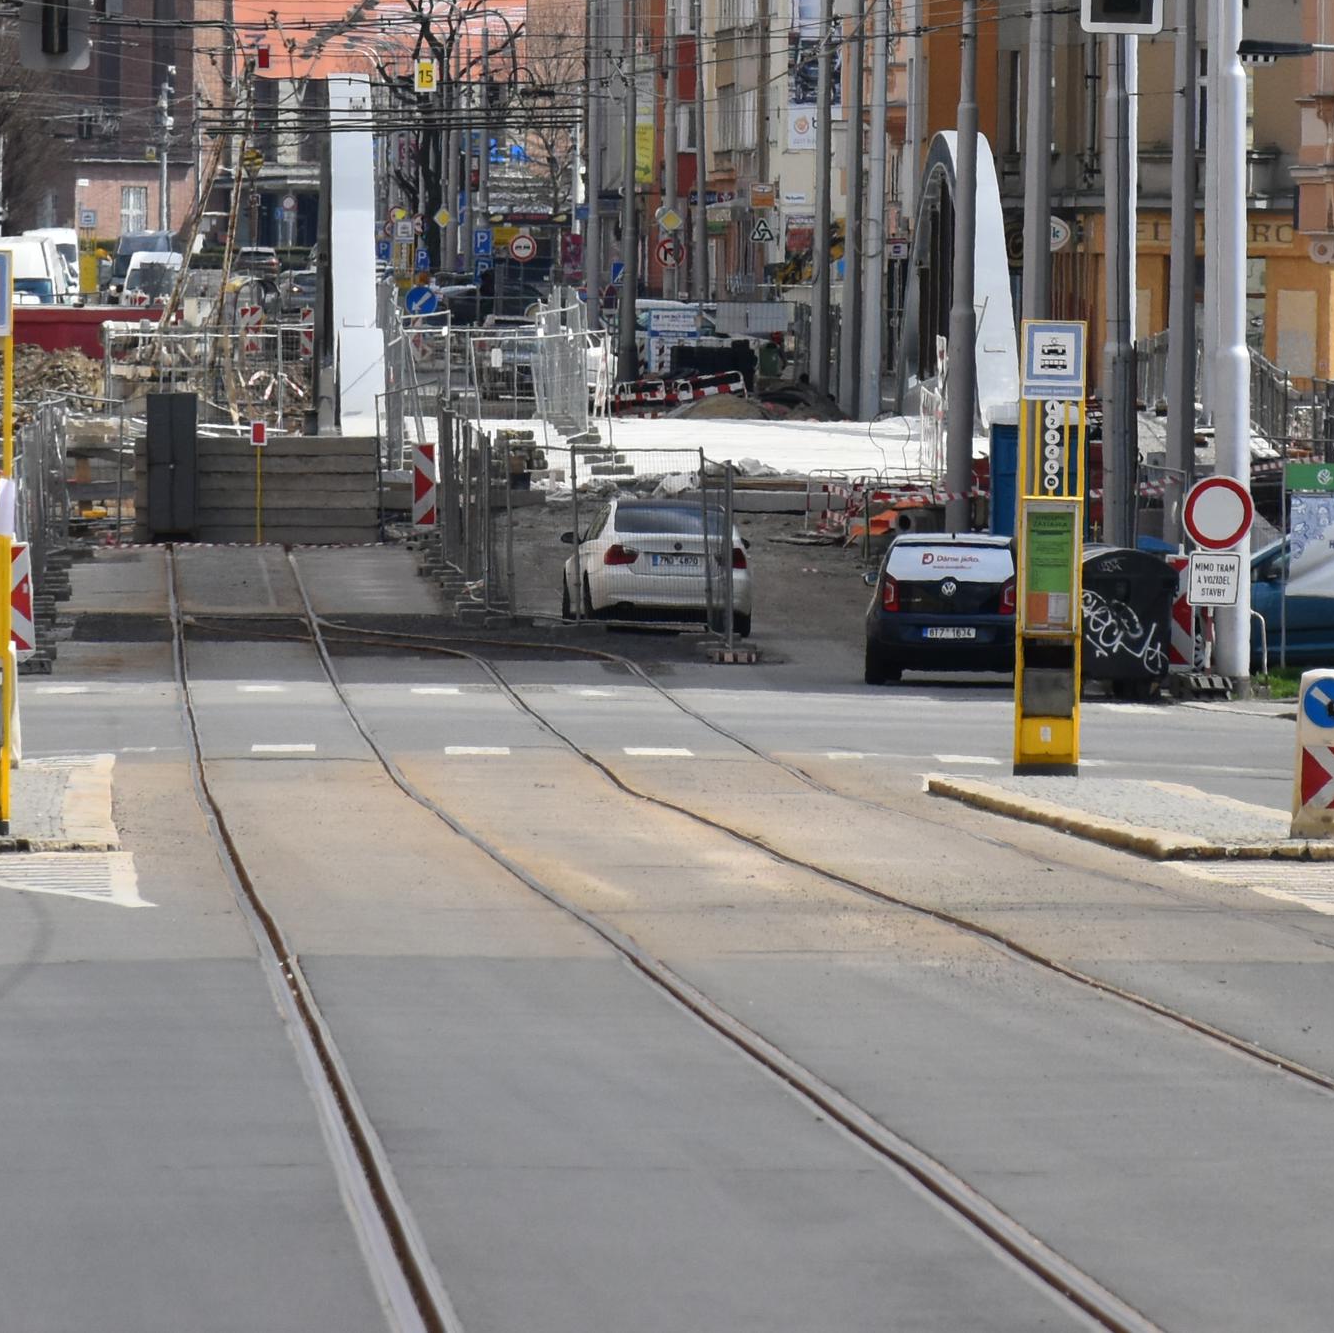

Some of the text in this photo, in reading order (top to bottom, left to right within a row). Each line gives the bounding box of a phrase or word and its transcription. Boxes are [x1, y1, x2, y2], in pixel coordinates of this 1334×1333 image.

[419, 69, 433, 83] 15
[1195, 562, 1235, 572] MIMO TRAM
[1204, 575, 1231, 585] VOZIDEL
[1201, 587, 1226, 597] STAVBY
